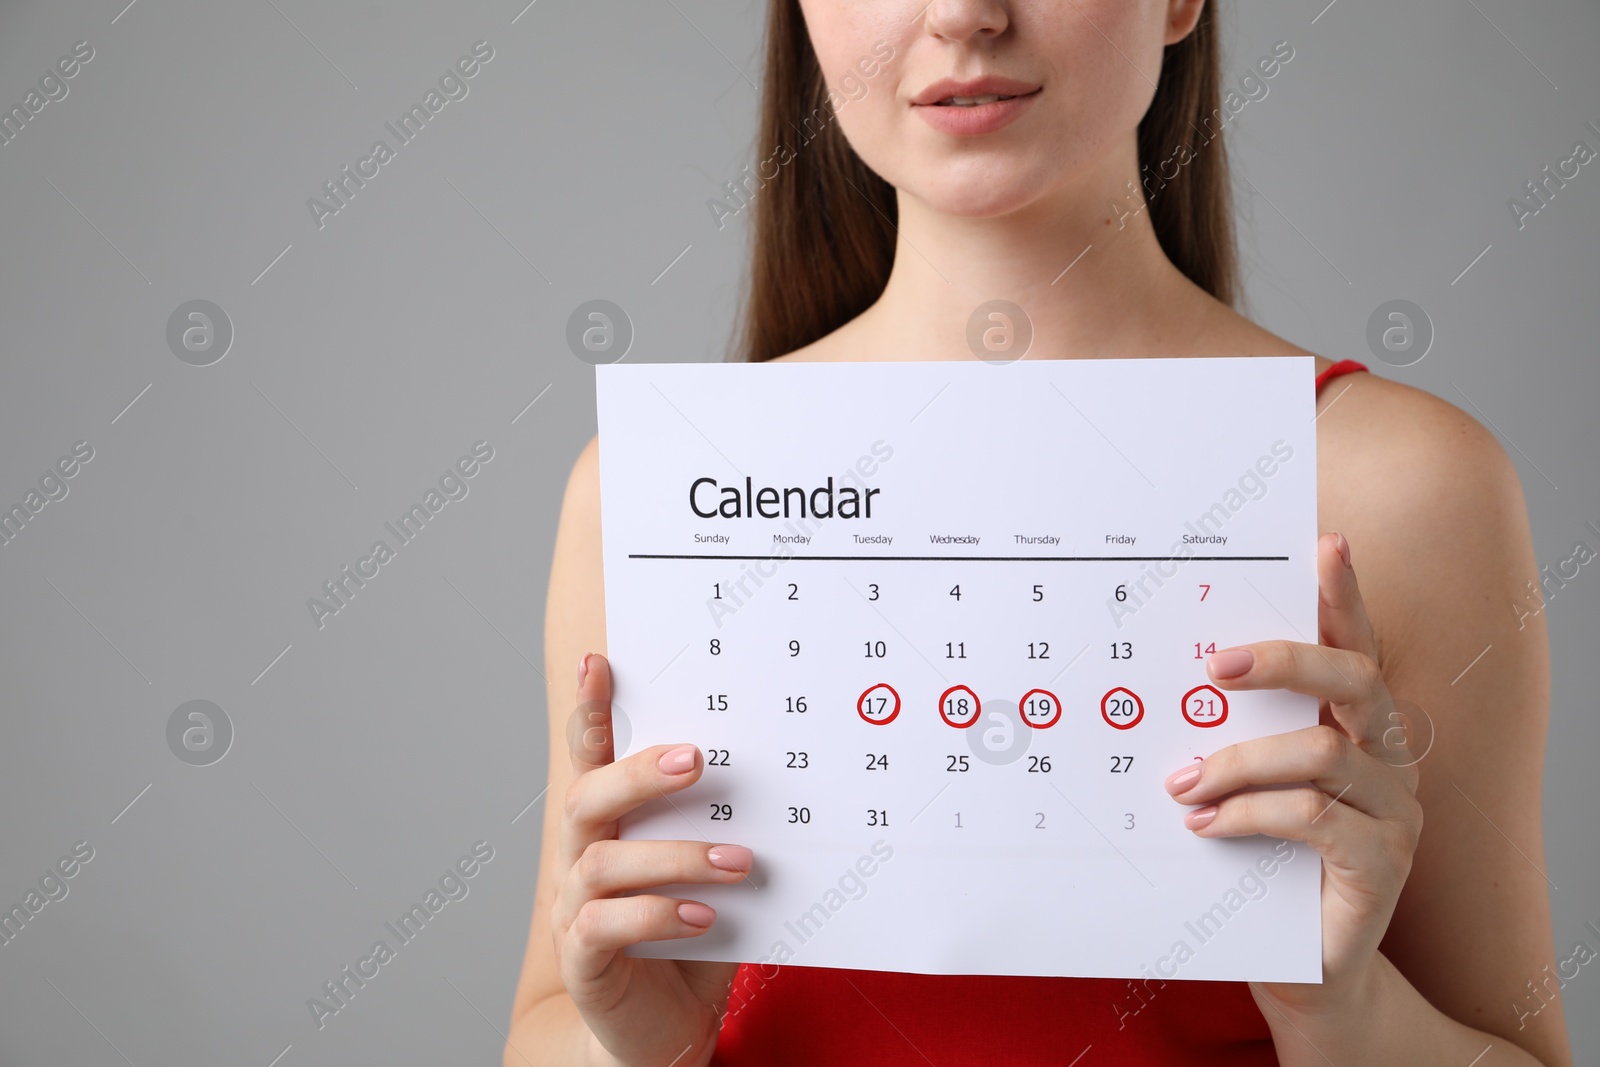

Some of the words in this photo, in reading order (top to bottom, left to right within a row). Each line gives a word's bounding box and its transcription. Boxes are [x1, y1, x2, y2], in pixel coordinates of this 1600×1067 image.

[689, 476, 881, 520] Calendar
[694, 533, 730, 545] Sunday
[773, 534, 811, 544] Monday
[852, 534, 893, 546] Tuesday
[929, 535, 981, 546] Wednesday
[1014, 534, 1061, 546] Thursday
[1105, 534, 1137, 546] Friday
[1182, 534, 1228, 546] Saturday
[713, 582, 723, 600] 1
[787, 583, 799, 601] 2
[868, 583, 880, 601] 3
[949, 584, 962, 602] 4
[1032, 584, 1044, 603] 5
[1114, 584, 1127, 603] 6
[1199, 584, 1211, 602] 7
[709, 638, 721, 656] 8
[788, 639, 801, 658] 9
[864, 640, 887, 659] 10
[945, 641, 967, 659] 11
[1027, 641, 1050, 660] 12
[1110, 641, 1133, 660] 13
[1194, 642, 1217, 660] 14
[707, 694, 728, 712] 15
[785, 696, 808, 714] 16
[864, 697, 888, 716] 17
[945, 698, 970, 717] 18
[1027, 699, 1052, 718] 19
[1109, 699, 1134, 718] 20
[1193, 698, 1217, 717] 21
[708, 749, 731, 767] 22
[786, 751, 809, 769] 23
[865, 753, 889, 771] 24
[946, 754, 970, 773] 25
[1027, 755, 1052, 774] 26
[1110, 755, 1134, 774] 27
[710, 803, 733, 821] 29
[787, 806, 811, 824] 30
[866, 809, 889, 827] 31
[954, 811, 964, 829] 1
[1034, 812, 1046, 830] 2
[1124, 812, 1136, 831] 3
